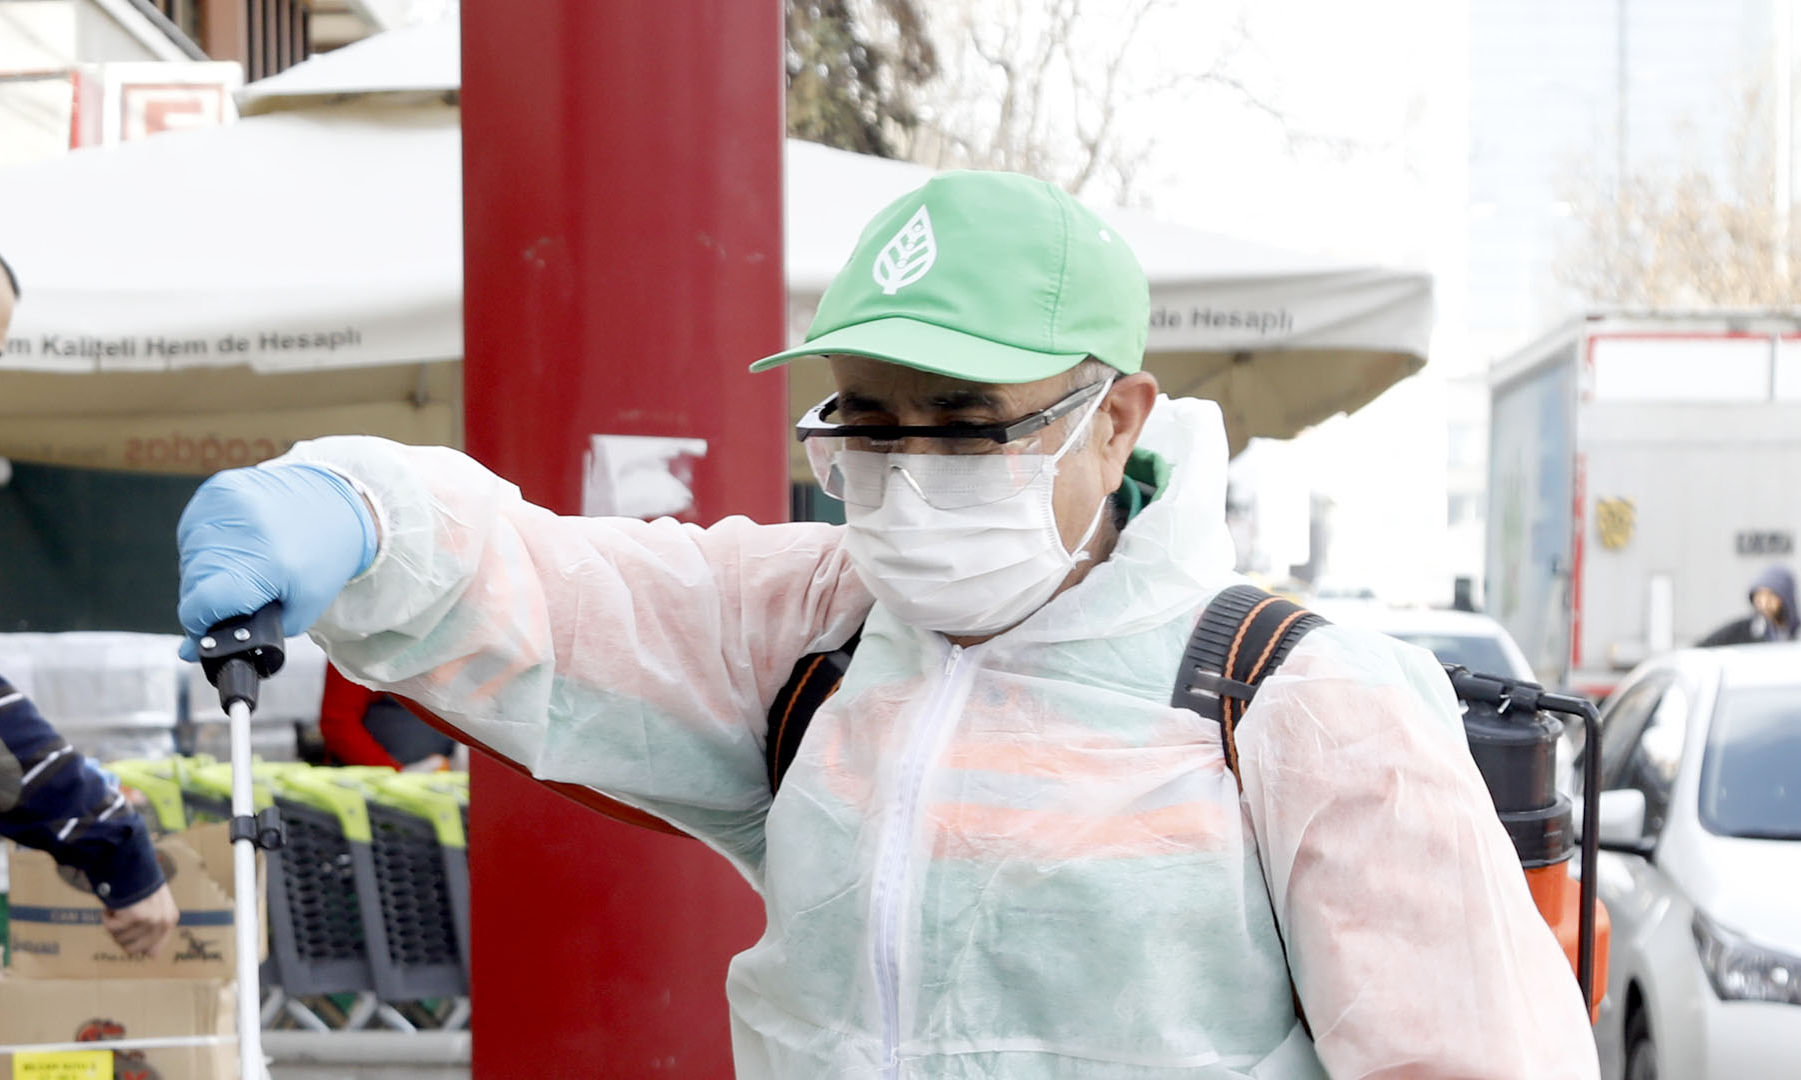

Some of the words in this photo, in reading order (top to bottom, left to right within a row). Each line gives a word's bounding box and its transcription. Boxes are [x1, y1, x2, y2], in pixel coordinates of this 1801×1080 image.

[42, 333, 136, 358] Kaliteli
[147, 337, 208, 358] Hem
[218, 334, 249, 353] de
